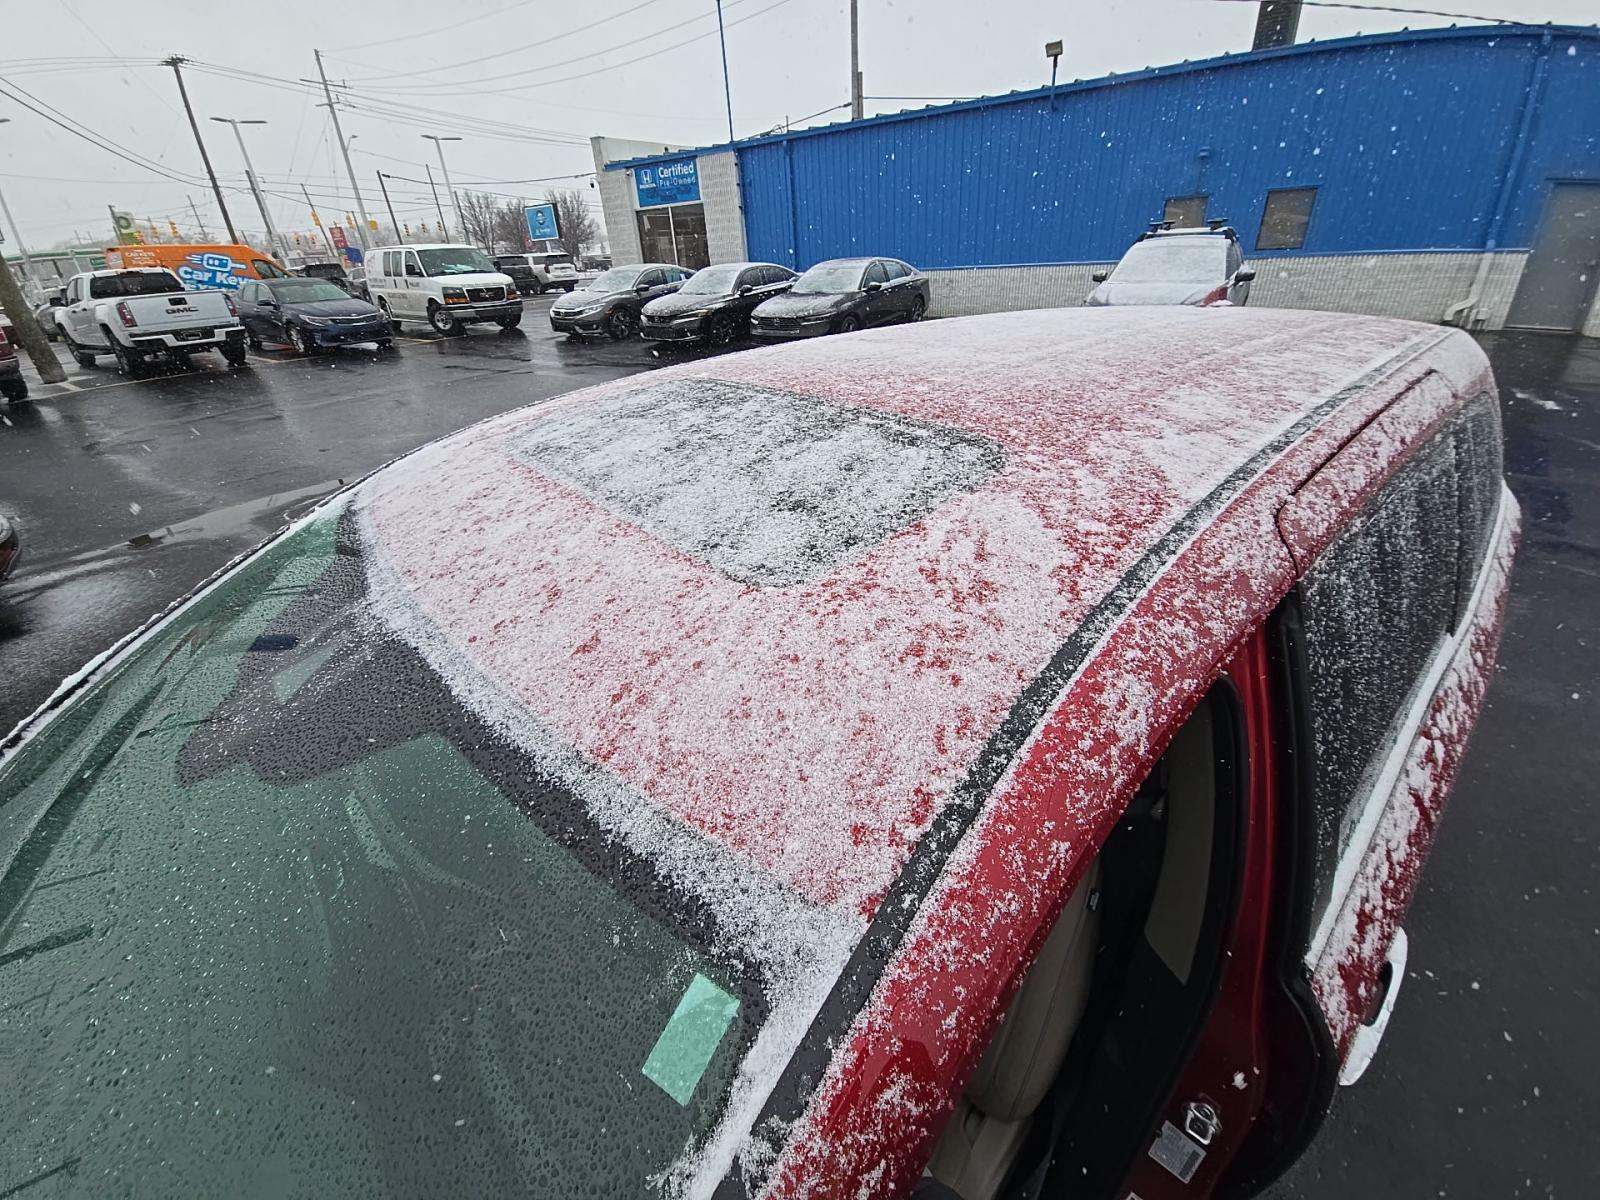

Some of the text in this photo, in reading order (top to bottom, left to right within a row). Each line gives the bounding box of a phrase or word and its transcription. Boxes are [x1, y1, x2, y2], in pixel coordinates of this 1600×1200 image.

[658, 162, 694, 178] Certified
[660, 176, 696, 187] Pre-Owned
[179, 267, 252, 286] Car Key
[165, 306, 199, 315] GMC
